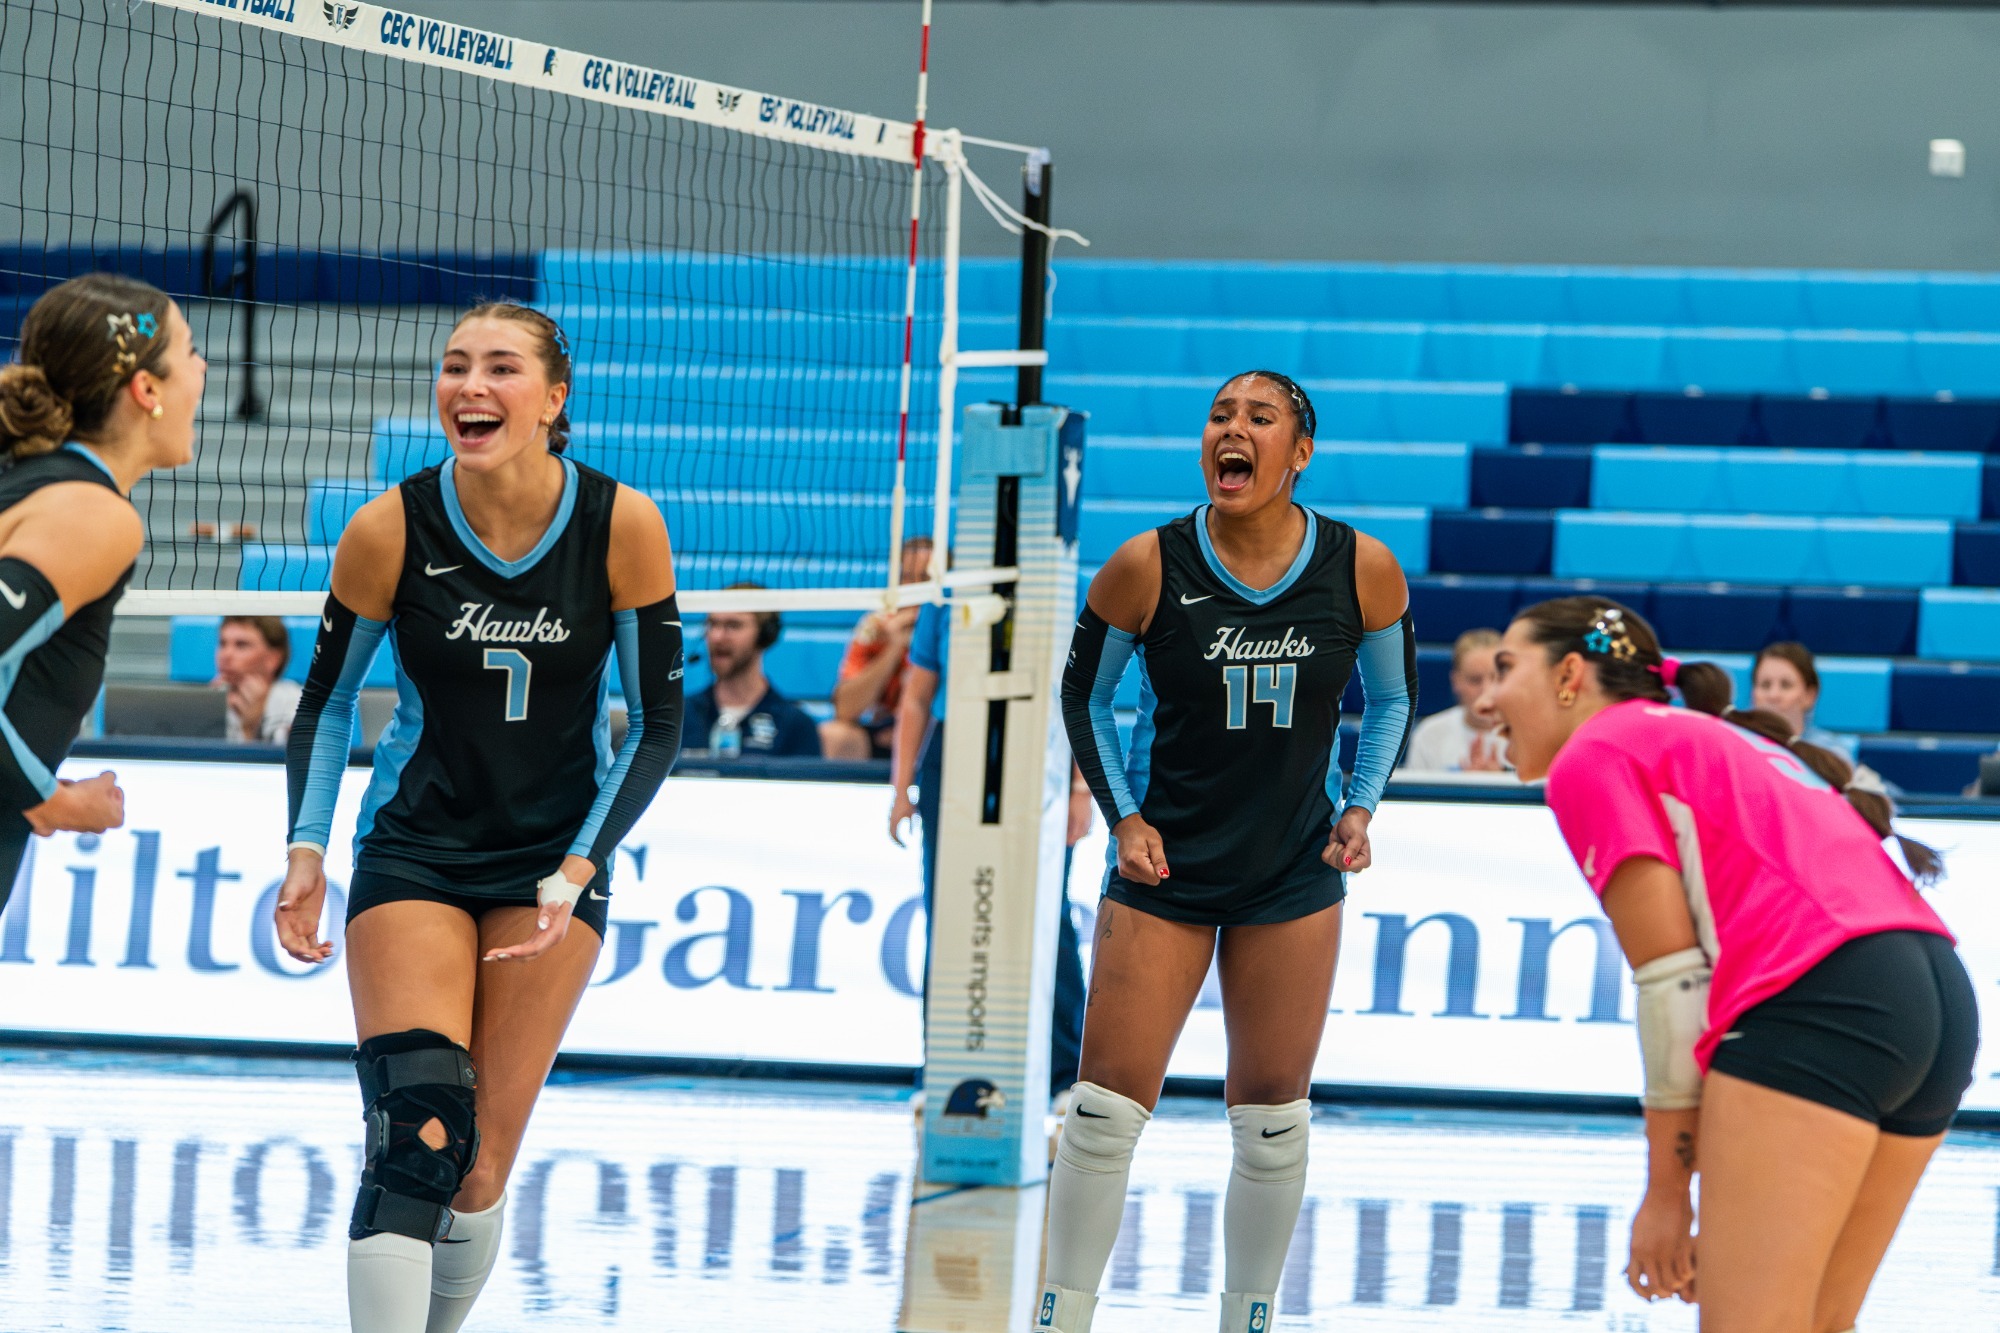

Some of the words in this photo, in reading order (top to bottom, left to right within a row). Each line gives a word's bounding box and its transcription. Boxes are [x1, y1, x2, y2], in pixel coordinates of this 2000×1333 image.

[381, 11, 415, 48] CBC
[418, 19, 514, 70] VOLLEYBALL
[583, 59, 613, 92] CBC
[616, 66, 697, 109] VOLLEYBALL
[445, 602, 570, 643] Hawks
[1203, 626, 1315, 660] Hawks
[483, 648, 532, 722] 7
[1223, 663, 1297, 730] 14
[971, 866, 995, 948] sports
[966, 951, 988, 1052] imports
[1328, 911, 1637, 1026] nn
